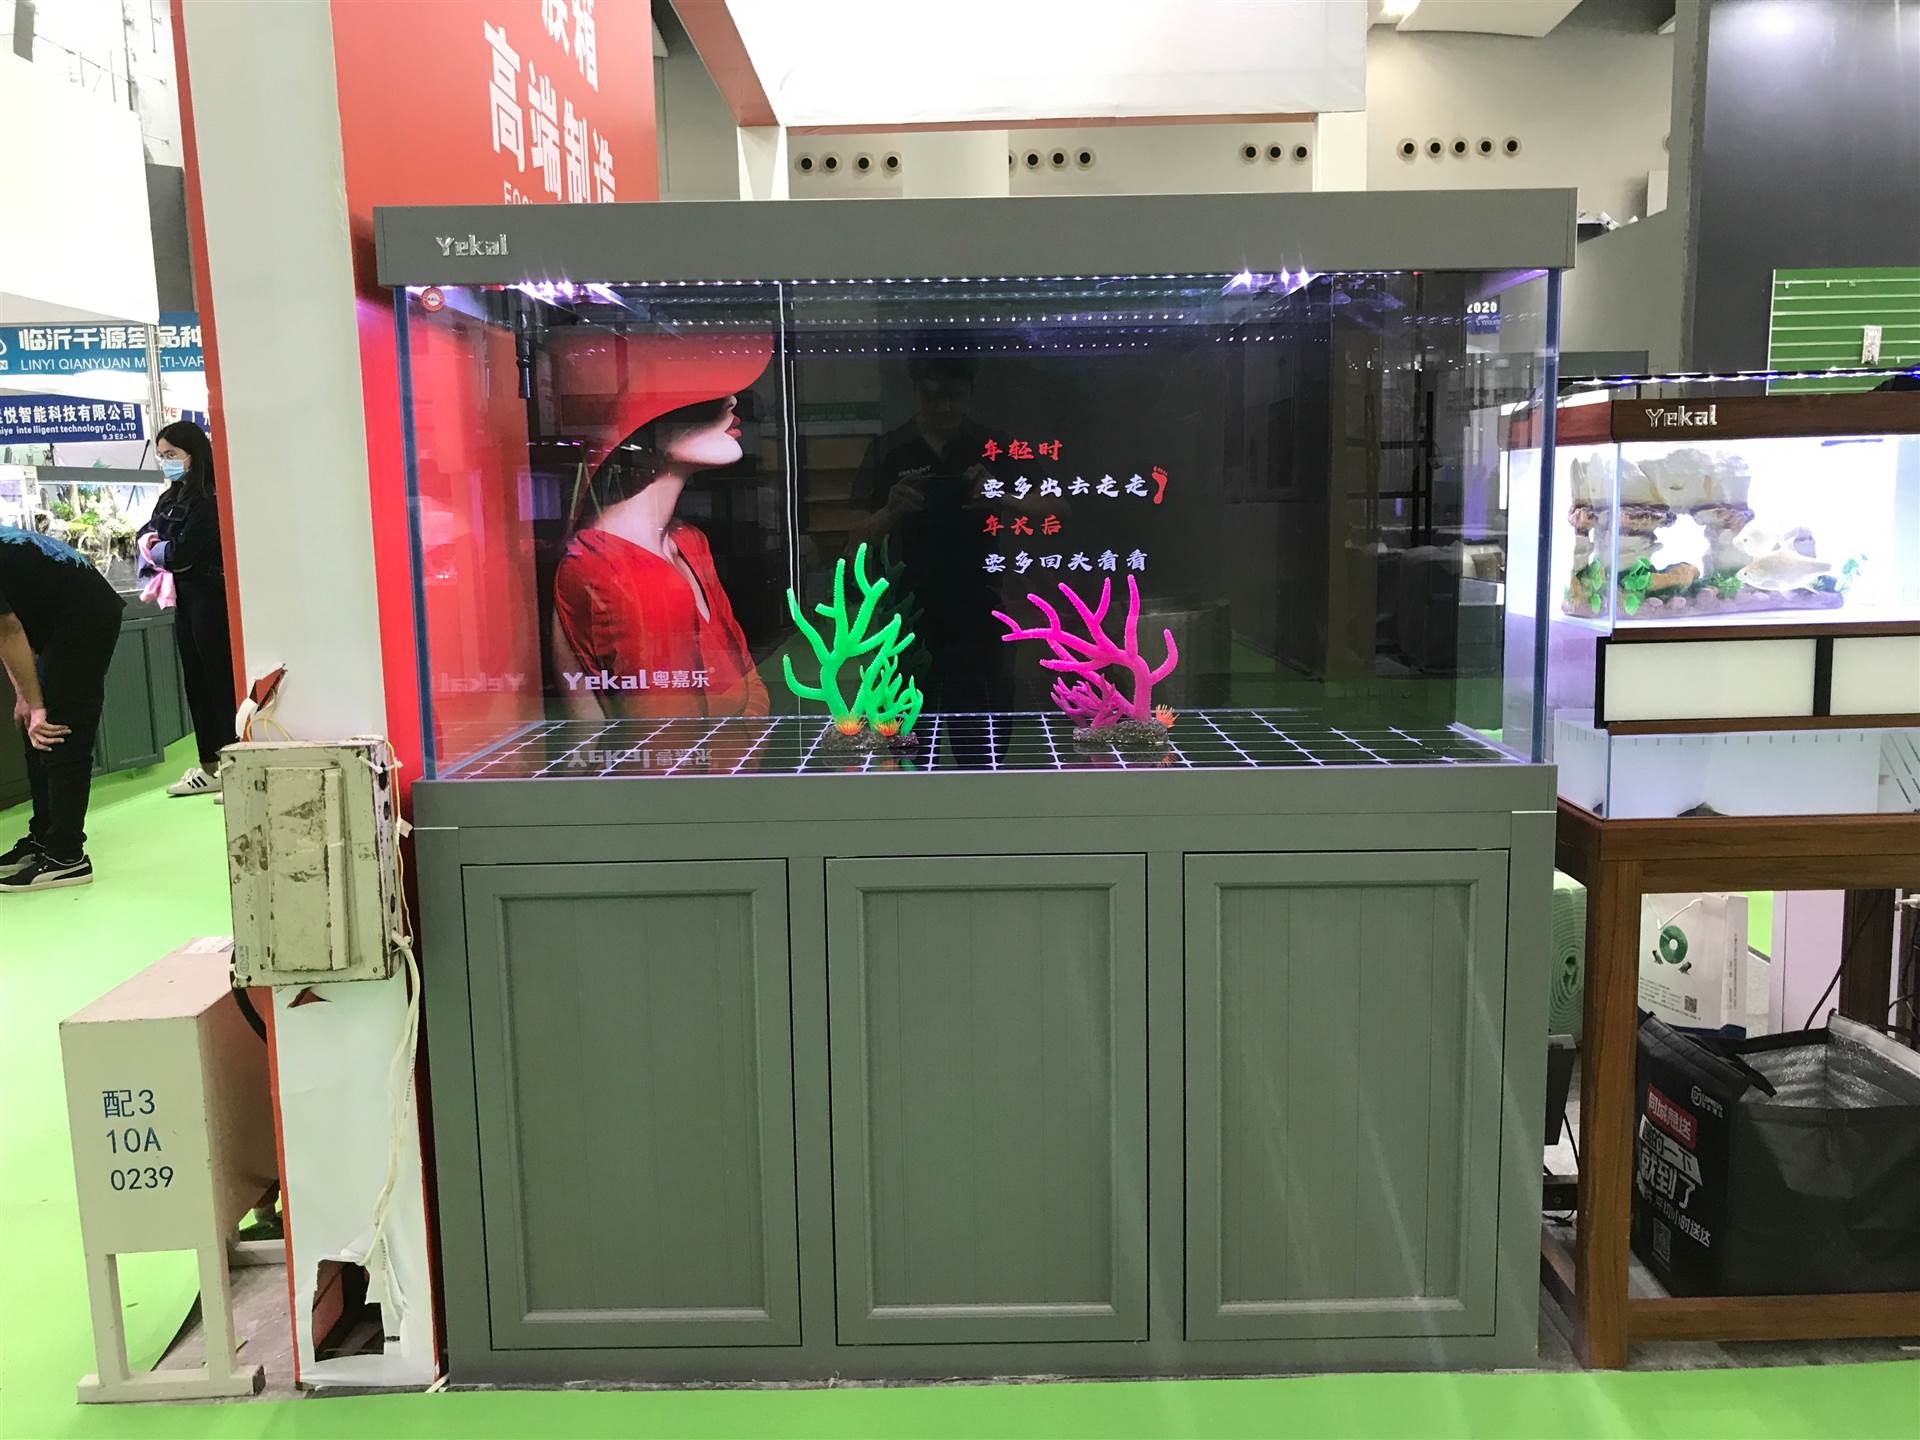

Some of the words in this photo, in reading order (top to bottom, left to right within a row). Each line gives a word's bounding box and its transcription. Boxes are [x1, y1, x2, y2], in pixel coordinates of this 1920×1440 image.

[484, 20, 615, 203] 高端制造
[436, 234, 509, 256] Yekal
[1467, 301, 1498, 314] 2020
[20, 358, 55, 371] LINYI
[58, 356, 130, 370] QIANYUAN
[1645, 404, 1718, 427] Yekal
[60, 423, 104, 434] technology
[981, 439, 1063, 462] 年轻时
[980, 474, 1149, 500] 要多出去走走
[982, 514, 1063, 537] 年长后
[981, 549, 1148, 574] 要多回头看看
[562, 669, 650, 691] Yekal
[652, 669, 711, 689] 粤嘉乐
[106, 1127, 162, 1154] 10A
[111, 1166, 174, 1191] 0239
